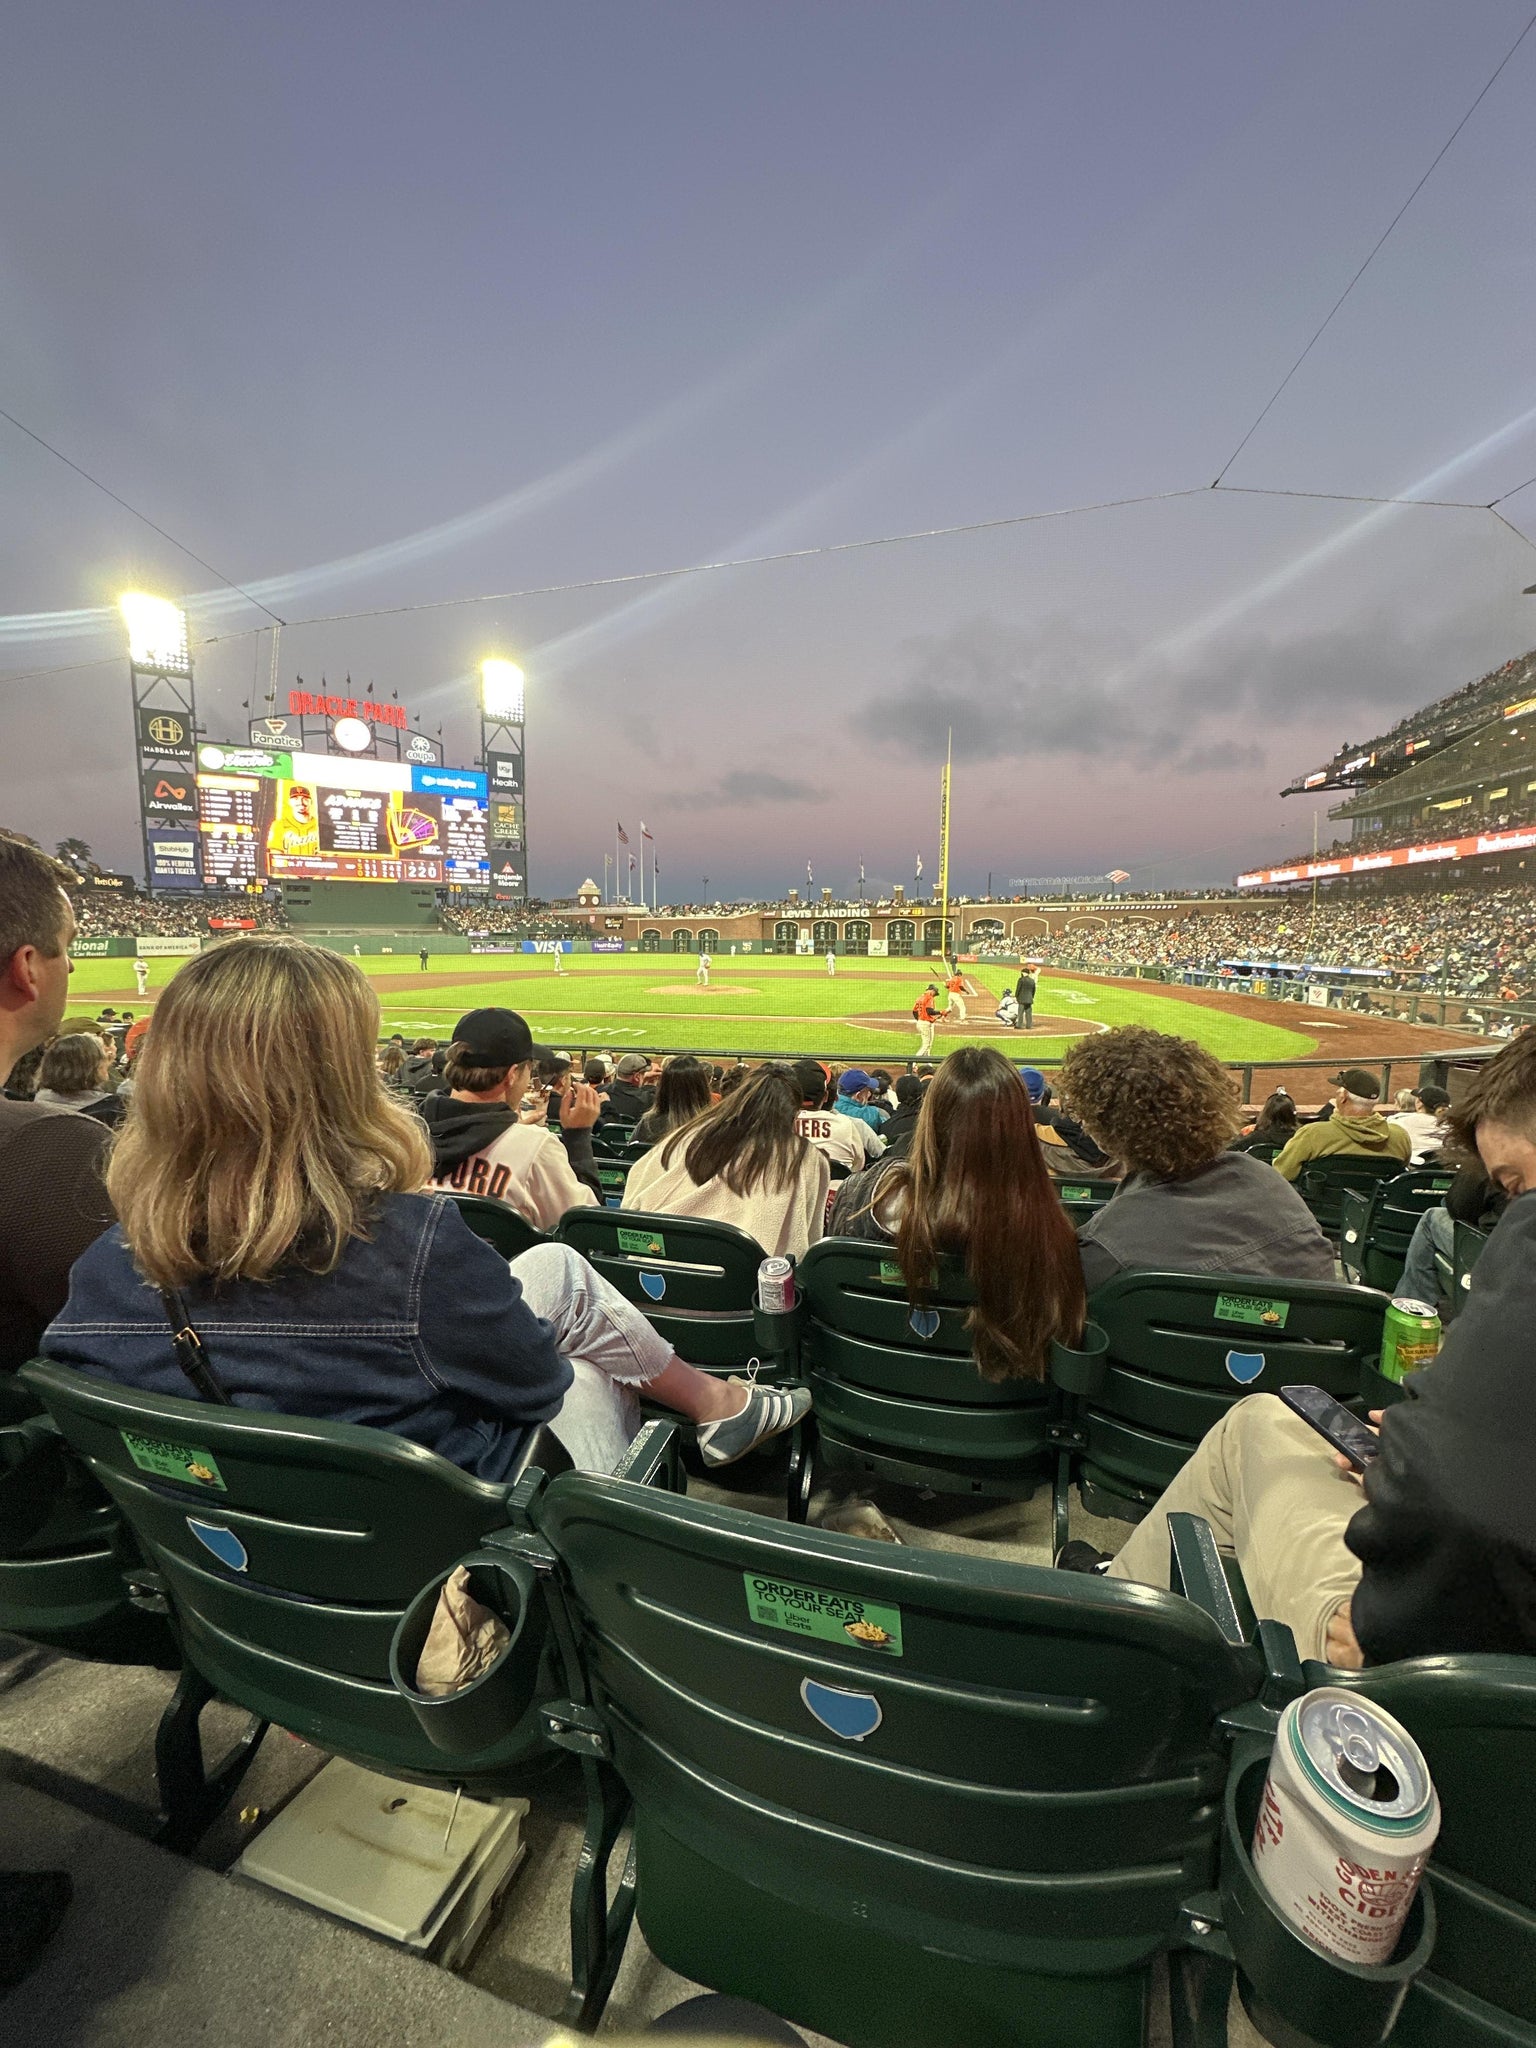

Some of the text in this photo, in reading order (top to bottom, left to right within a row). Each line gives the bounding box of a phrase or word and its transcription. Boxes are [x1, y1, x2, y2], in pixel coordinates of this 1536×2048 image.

[289, 690, 408, 730] ORACLE PARK
[251, 731, 303, 748] Fanatics
[143, 746, 190, 756] HABBAS LAW
[406, 750, 436, 763] coupa
[492, 778, 519, 788] Health
[149, 801, 194, 812] Airwallex
[159, 845, 190, 853] StubHub
[493, 873, 523, 881] Benjamin
[815, 908, 870, 918] LANDING
[73, 941, 109, 951] tional
[532, 940, 564, 953] VISA
[1221, 1296, 1273, 1309] ORDER EATS
[752, 1579, 865, 1614] ORDER EATS
[755, 1591, 865, 1624] TO YOUR SEAT
[784, 1611, 812, 1623] Uber
[785, 1618, 812, 1631] Eats
[1320, 1901, 1348, 1925] WEST
